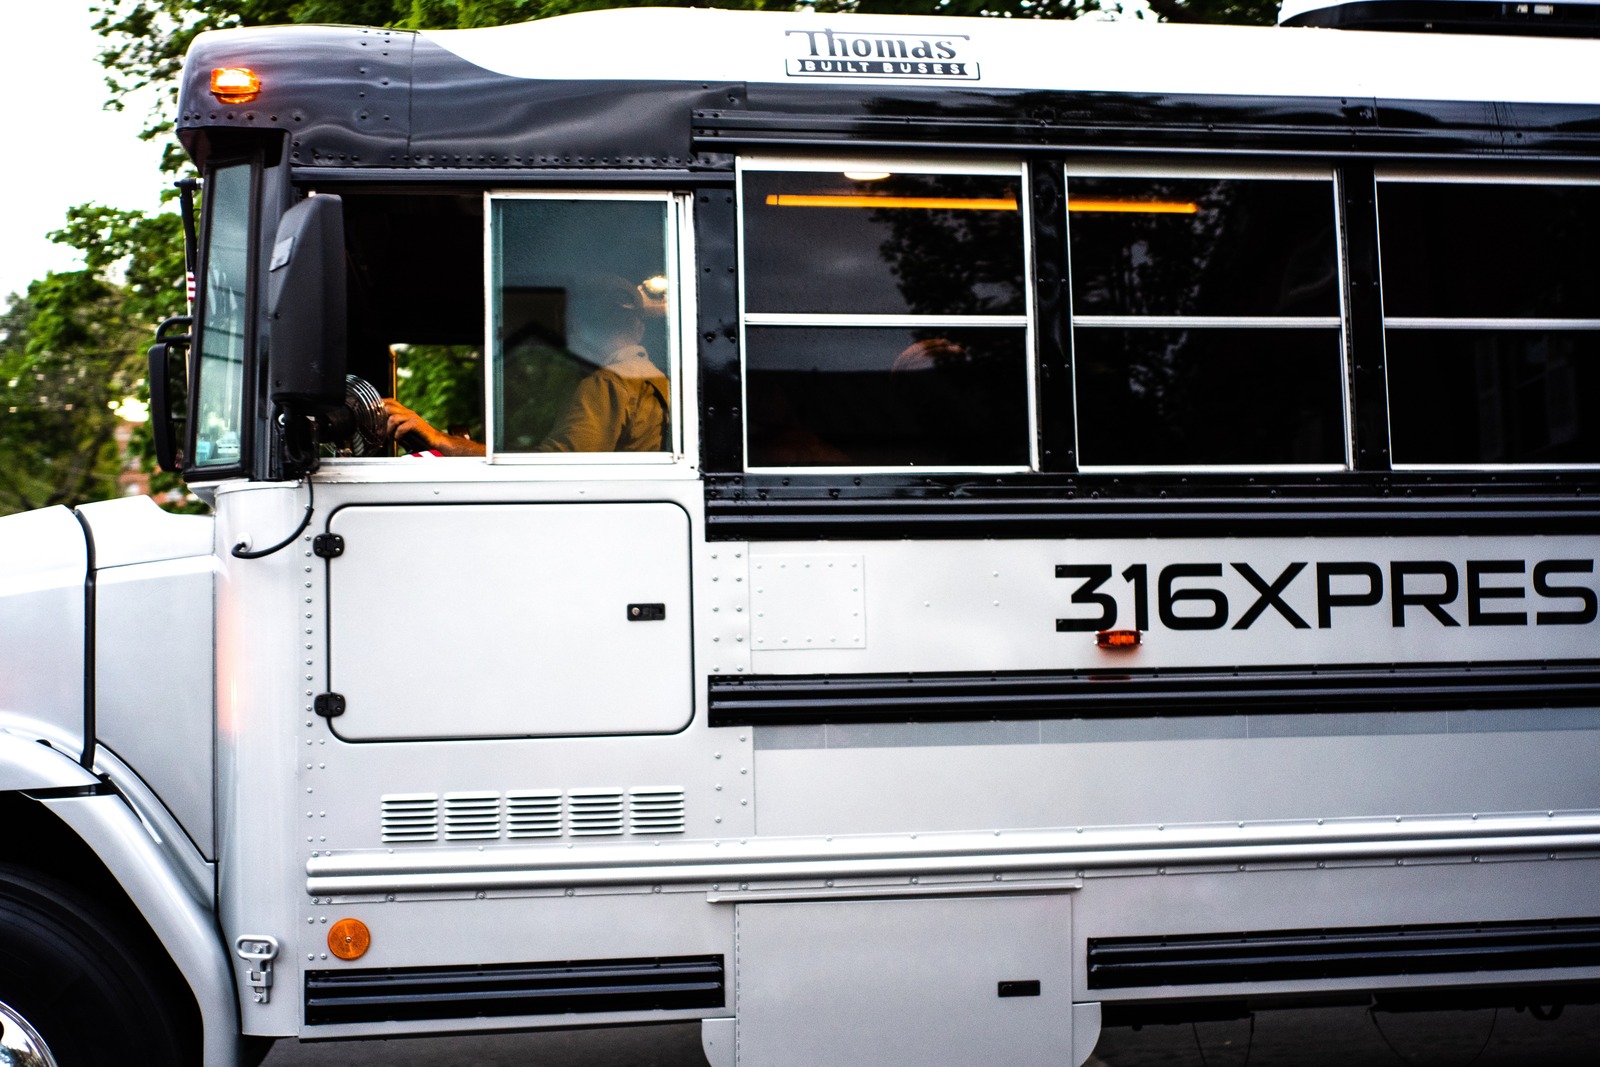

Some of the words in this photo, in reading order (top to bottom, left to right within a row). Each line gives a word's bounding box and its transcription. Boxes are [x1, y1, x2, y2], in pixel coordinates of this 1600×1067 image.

[785, 28, 970, 59] Thomas
[805, 60, 870, 72] BUILT
[883, 62, 960, 74] BUSES
[1055, 559, 1598, 632] 316XPRES
